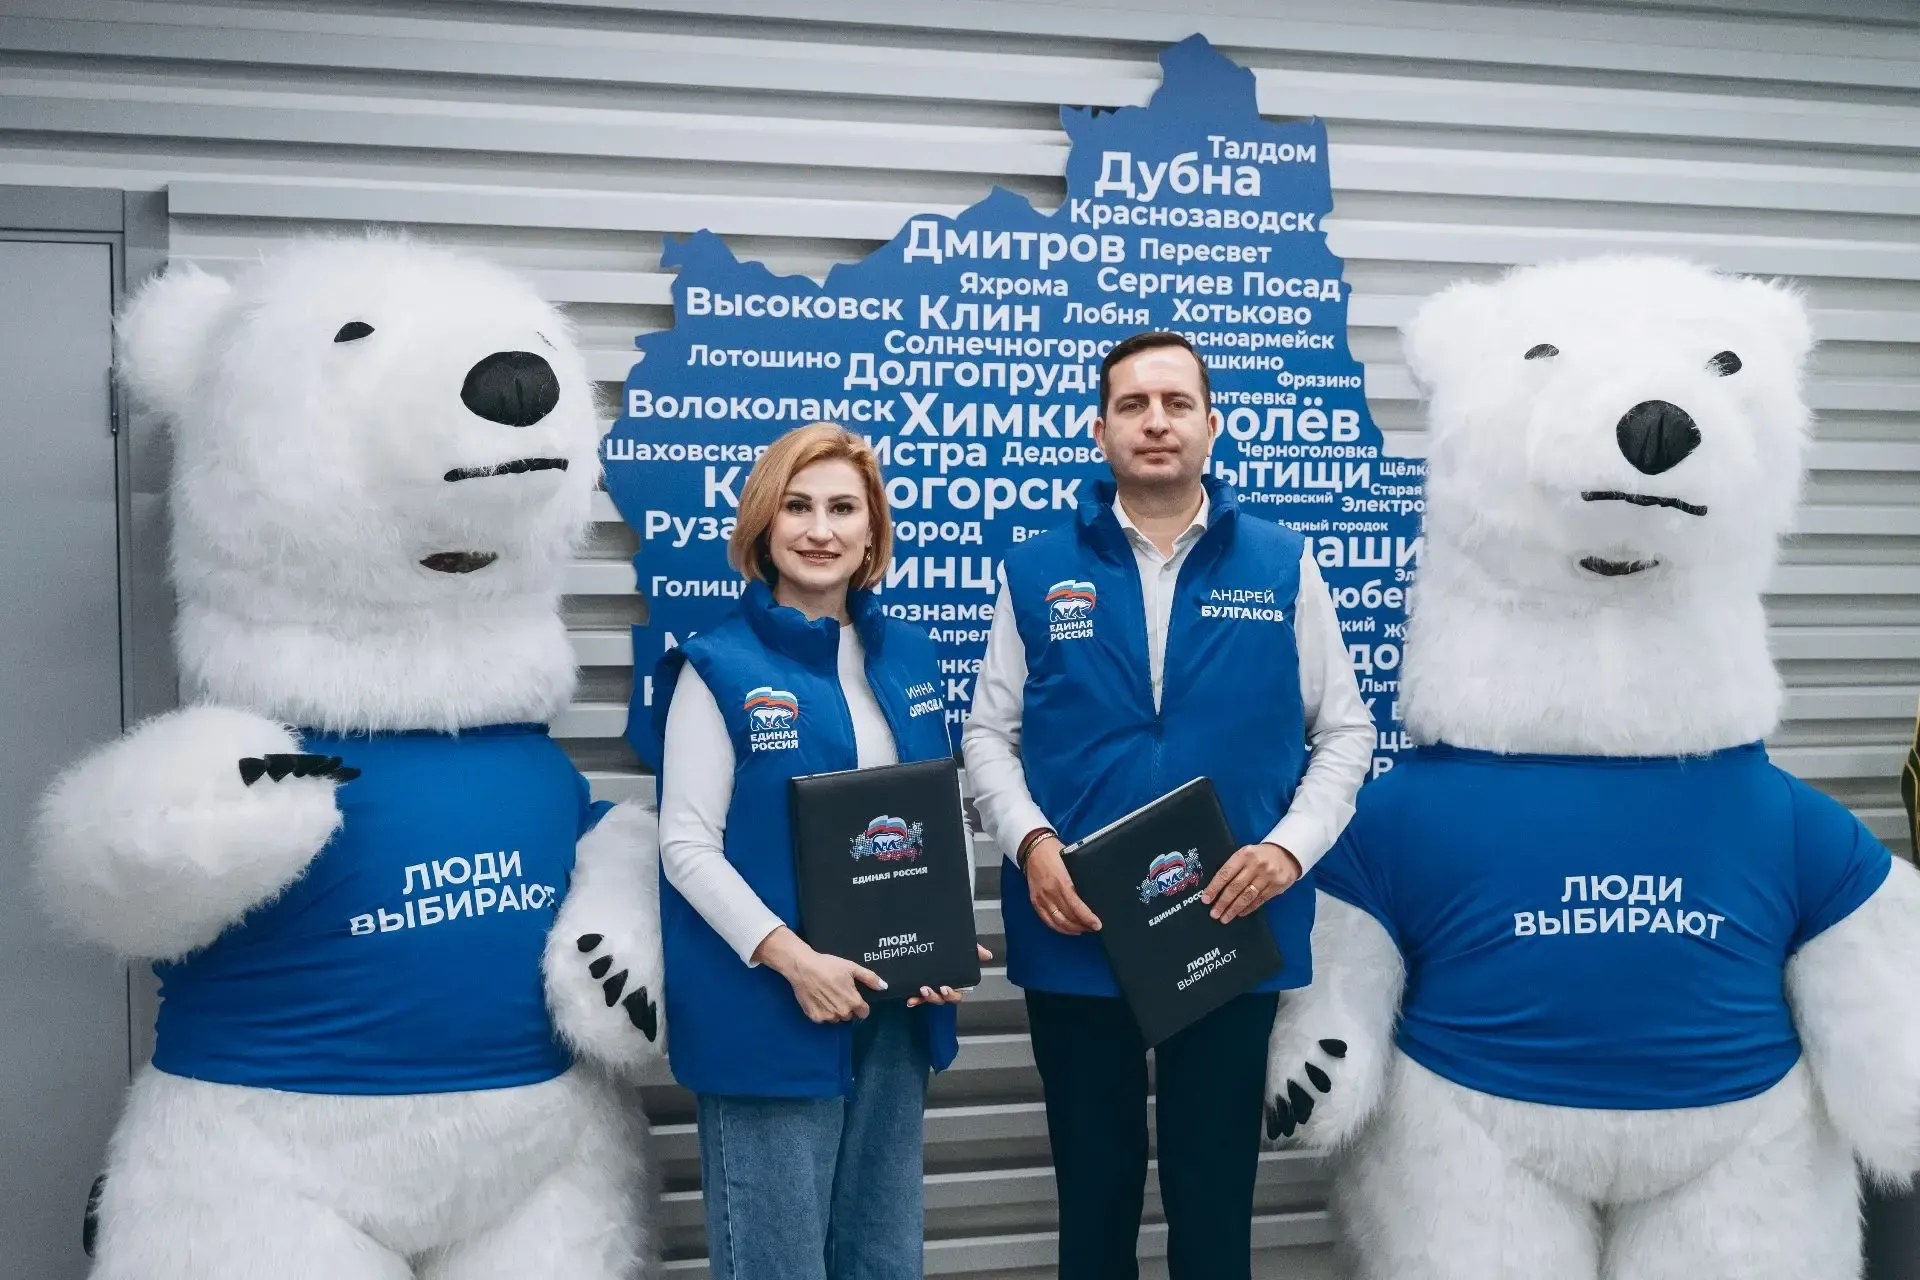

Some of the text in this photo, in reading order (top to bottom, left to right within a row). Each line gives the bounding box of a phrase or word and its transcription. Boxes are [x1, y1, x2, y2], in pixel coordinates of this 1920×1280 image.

[1208, 135, 1316, 163] Талдом
[1095, 151, 1261, 202] Дубна
[1070, 198, 1316, 234] Краснозаводск
[904, 220, 1126, 270] Дмитров
[1140, 238, 1272, 265] Пересвет
[960, 272, 1069, 300] Яхрома
[1097, 267, 1341, 301] Сергиев Посад
[686, 287, 904, 321] Высоковск
[920, 295, 1041, 332] Клин
[1063, 302, 1150, 326] Лобня
[1172, 299, 1312, 325] Хотьково
[687, 344, 841, 369] Лотошино
[884, 330, 1121, 363] Солнечногорс
[1277, 371, 1362, 390] Фрязино
[628, 389, 895, 421] Волоколамск
[900, 392, 1098, 438] Химки
[1238, 441, 1378, 460] Черноголовка
[1203, 457, 1370, 493] ытищи
[1370, 483, 1423, 498] Старая
[1341, 496, 1425, 516] Электро
[645, 511, 738, 548] Руза
[892, 521, 983, 550] ород
[1332, 521, 1388, 533] городок
[1210, 588, 1275, 604] АНДРЕЙ
[1050, 620, 1093, 632] ЕДИНАЯ
[1201, 605, 1284, 622] БУЛГАКОВ
[1050, 629, 1094, 642] РОССИЯ
[905, 681, 936, 699] ИННА
[750, 730, 798, 742] ЕДИНАЯ
[751, 740, 799, 752] РОССИЯ
[403, 850, 522, 895] ЛЮДИ
[852, 866, 928, 885] ЕДИНАЯ РОССИЯ
[1561, 874, 1683, 906] ЛЮДИ
[350, 883, 556, 936] ВЫБИРАЮТ
[1148, 903, 1182, 927] ЕДИНАЯ
[1513, 907, 1725, 939] ВЫБИРАЮТ
[863, 942, 935, 962] ВЫБИРАЮТ
[878, 932, 918, 948] ЛЮДИ
[1177, 949, 1238, 991] ВЫБИРАЮТ
[1186, 947, 1221, 973] ЛЮДИ
